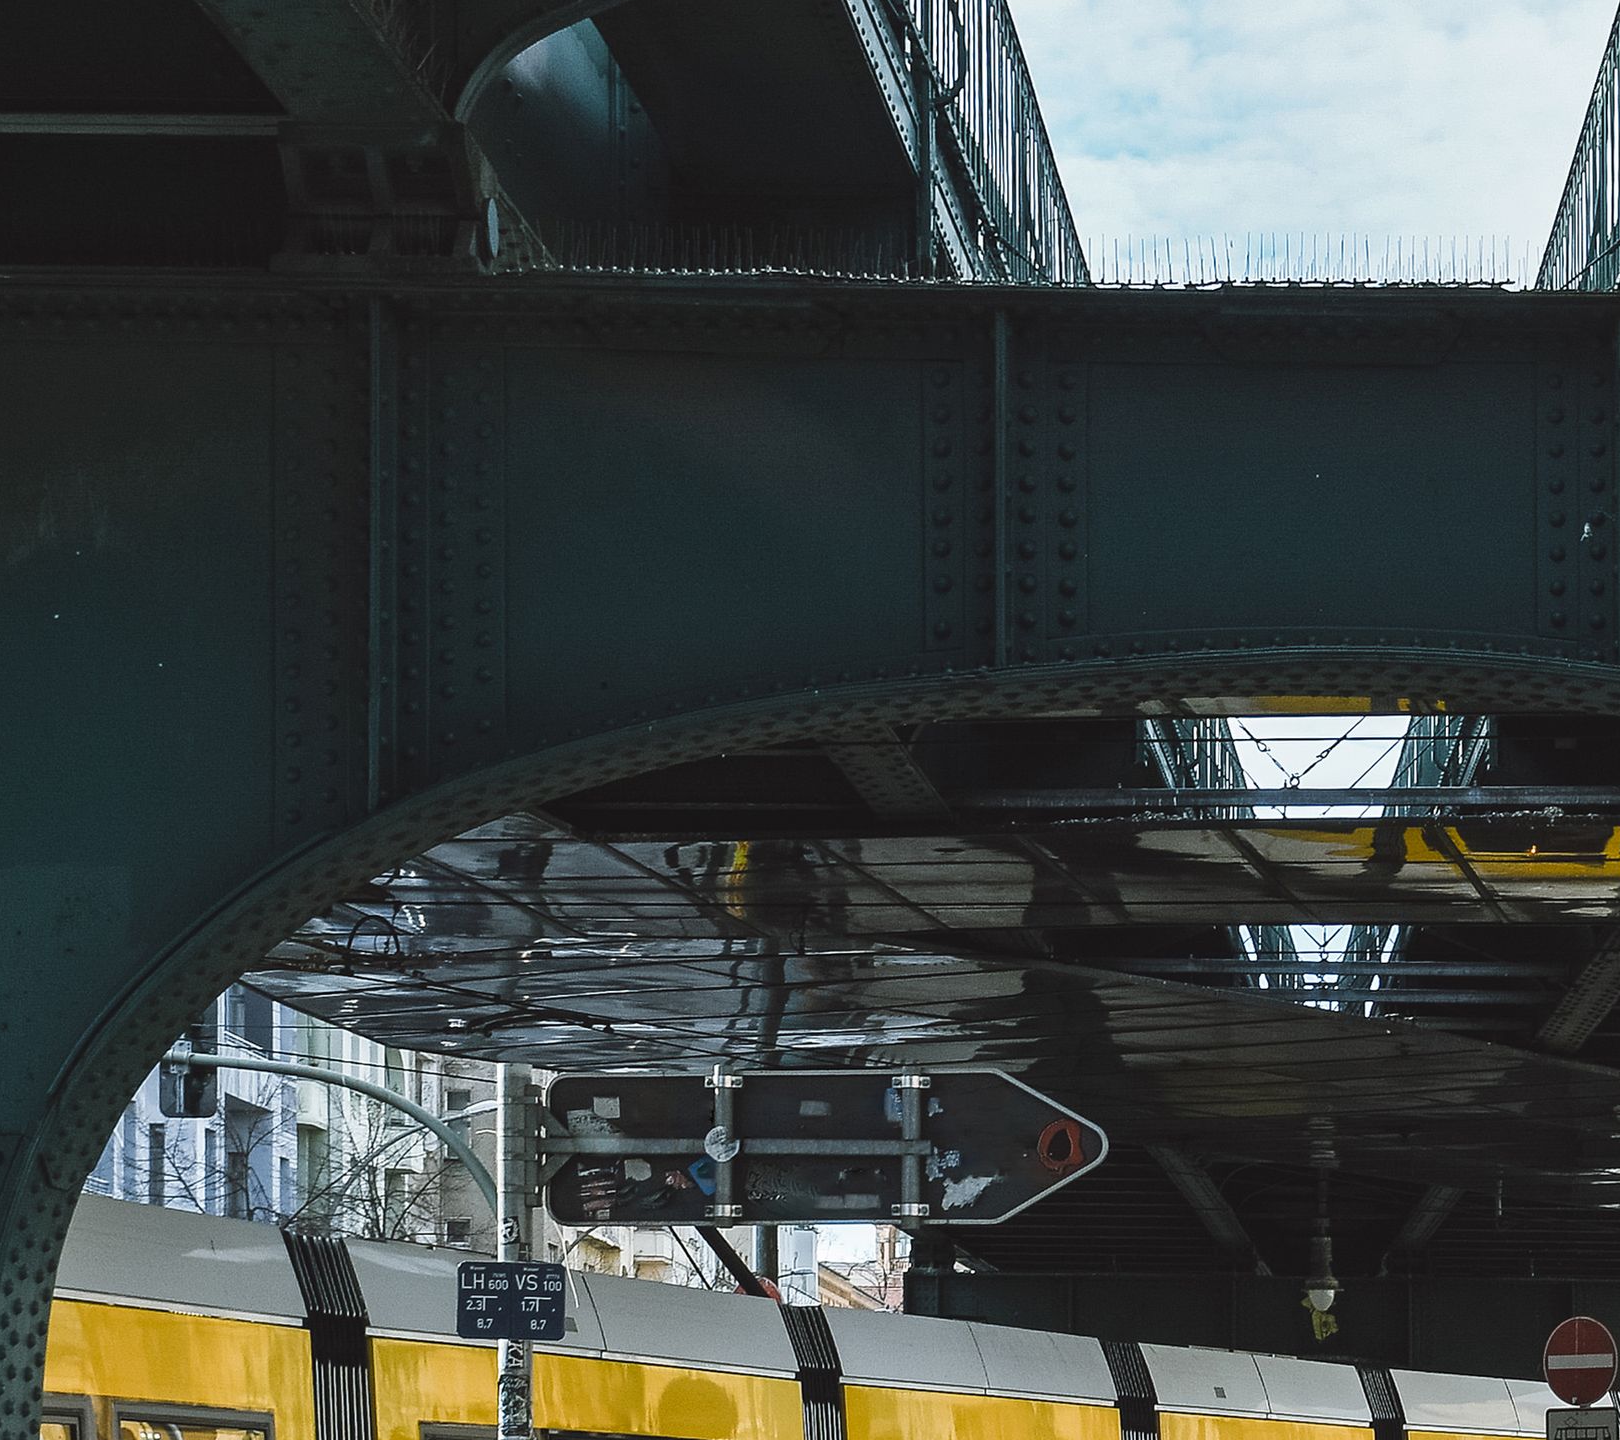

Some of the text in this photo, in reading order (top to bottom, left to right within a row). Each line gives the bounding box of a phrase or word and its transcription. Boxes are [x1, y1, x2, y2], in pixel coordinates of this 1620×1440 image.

[461, 1273, 509, 1290] LH 600
[515, 1274, 562, 1291] VS 100
